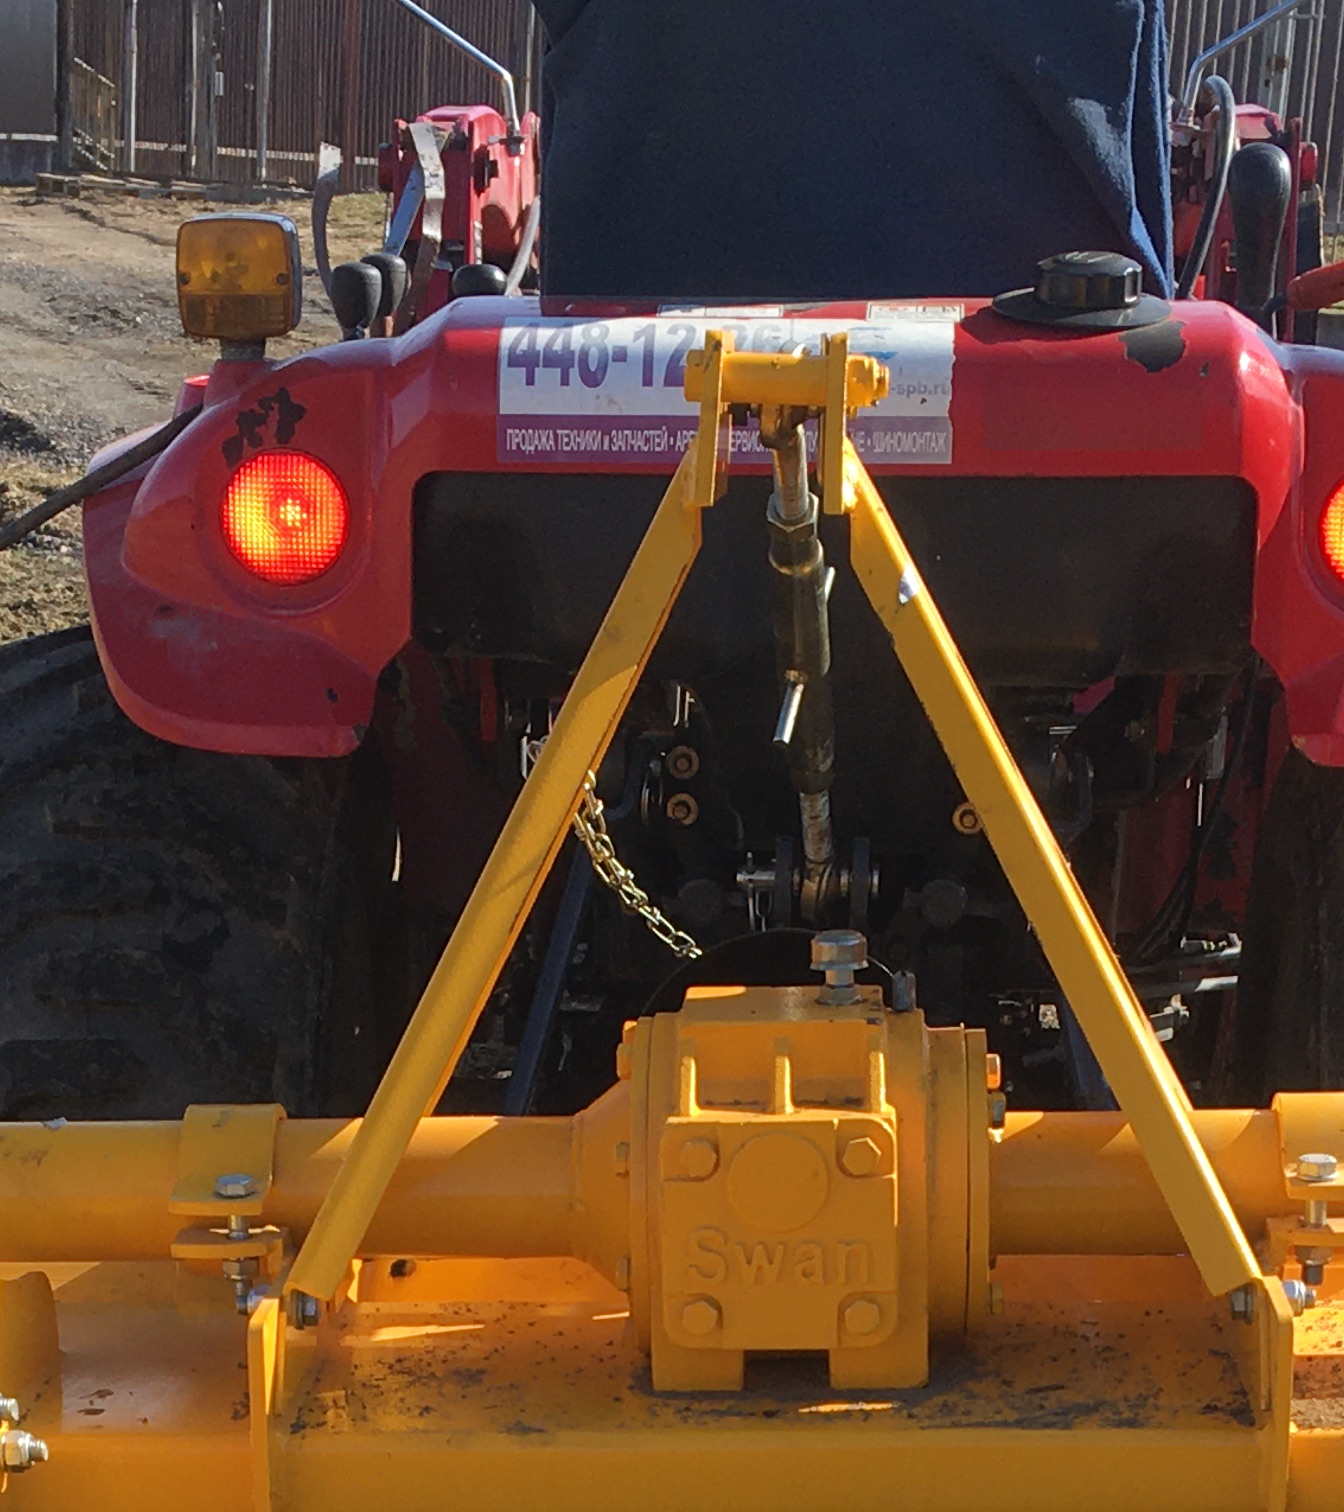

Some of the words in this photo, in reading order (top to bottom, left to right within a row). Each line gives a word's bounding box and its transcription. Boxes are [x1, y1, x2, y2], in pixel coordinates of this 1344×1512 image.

[507, 321, 782, 388] 448-12
[506, 428, 555, 455] ПРОДАЖА
[557, 429, 602, 452] ТЕХНИКИ
[610, 425, 669, 453] ЗАПЧАСТЕЙ
[873, 430, 947, 453] ШИНОМОНТАЖ
[688, 1224, 873, 1286] Swan
